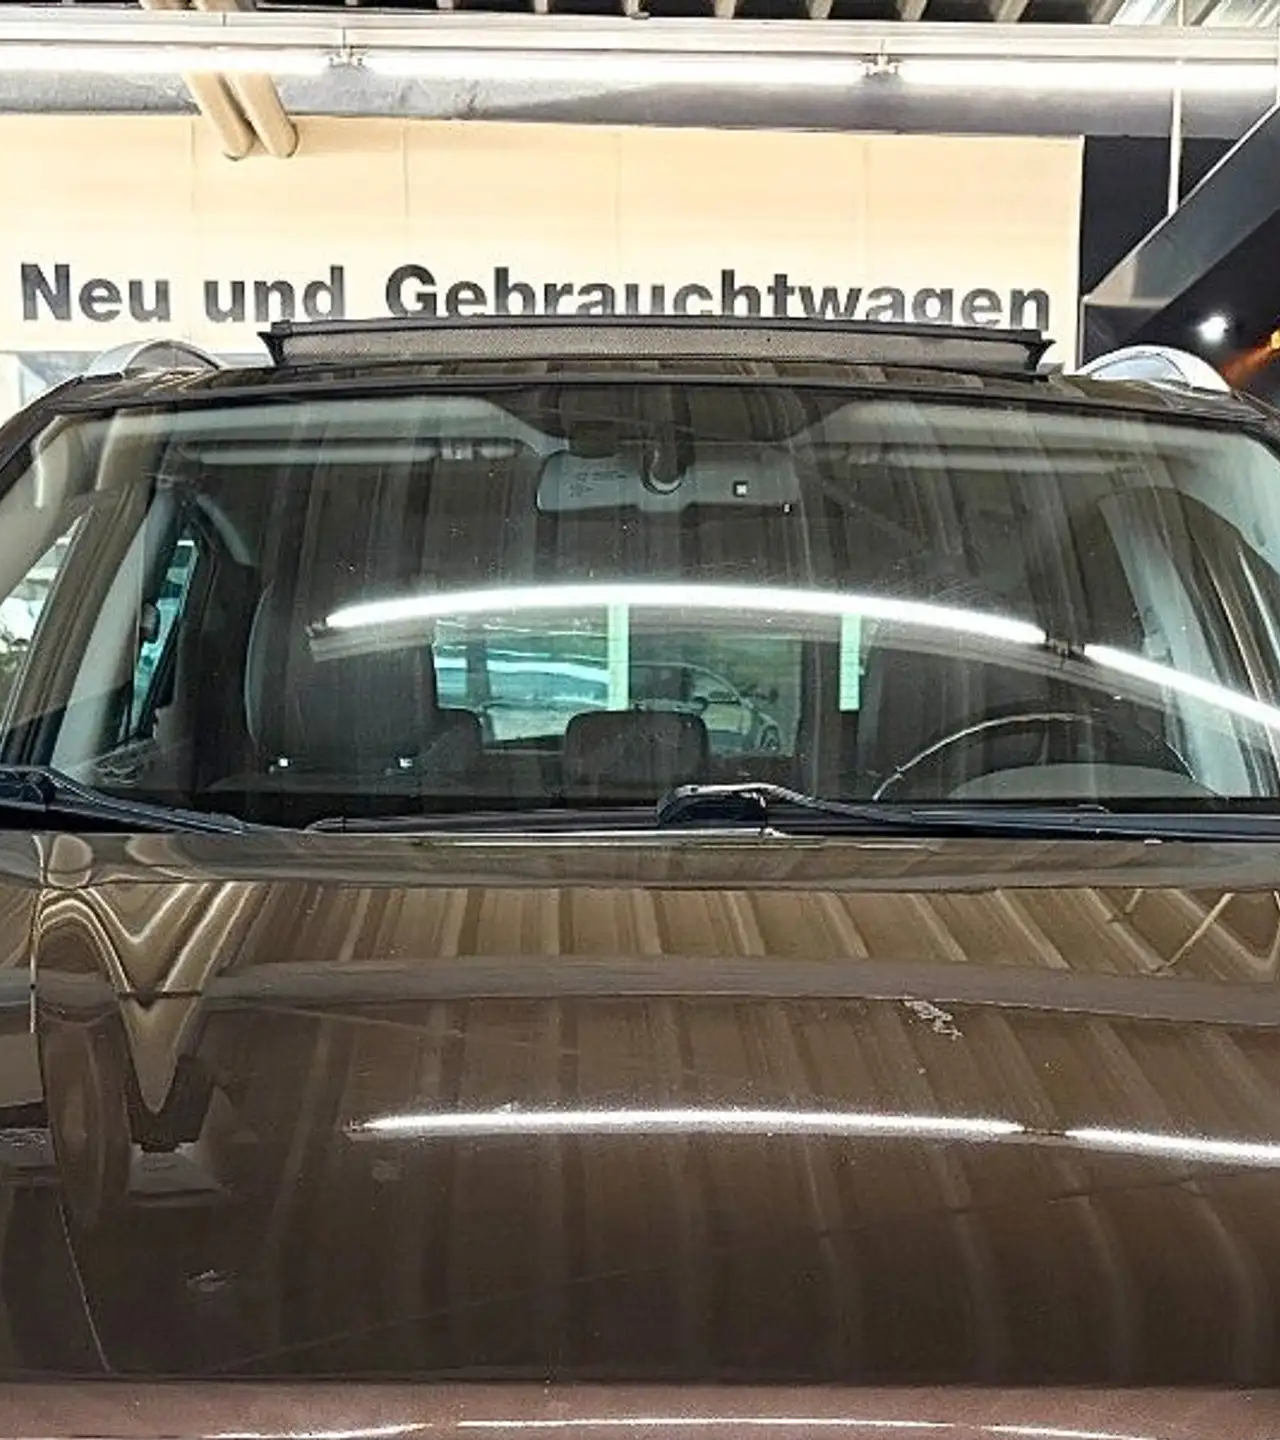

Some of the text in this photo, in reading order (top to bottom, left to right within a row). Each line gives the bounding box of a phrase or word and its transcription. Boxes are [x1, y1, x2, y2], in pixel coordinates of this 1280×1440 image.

[21, 263, 1050, 331] Neu und Gebrauchtwagen
